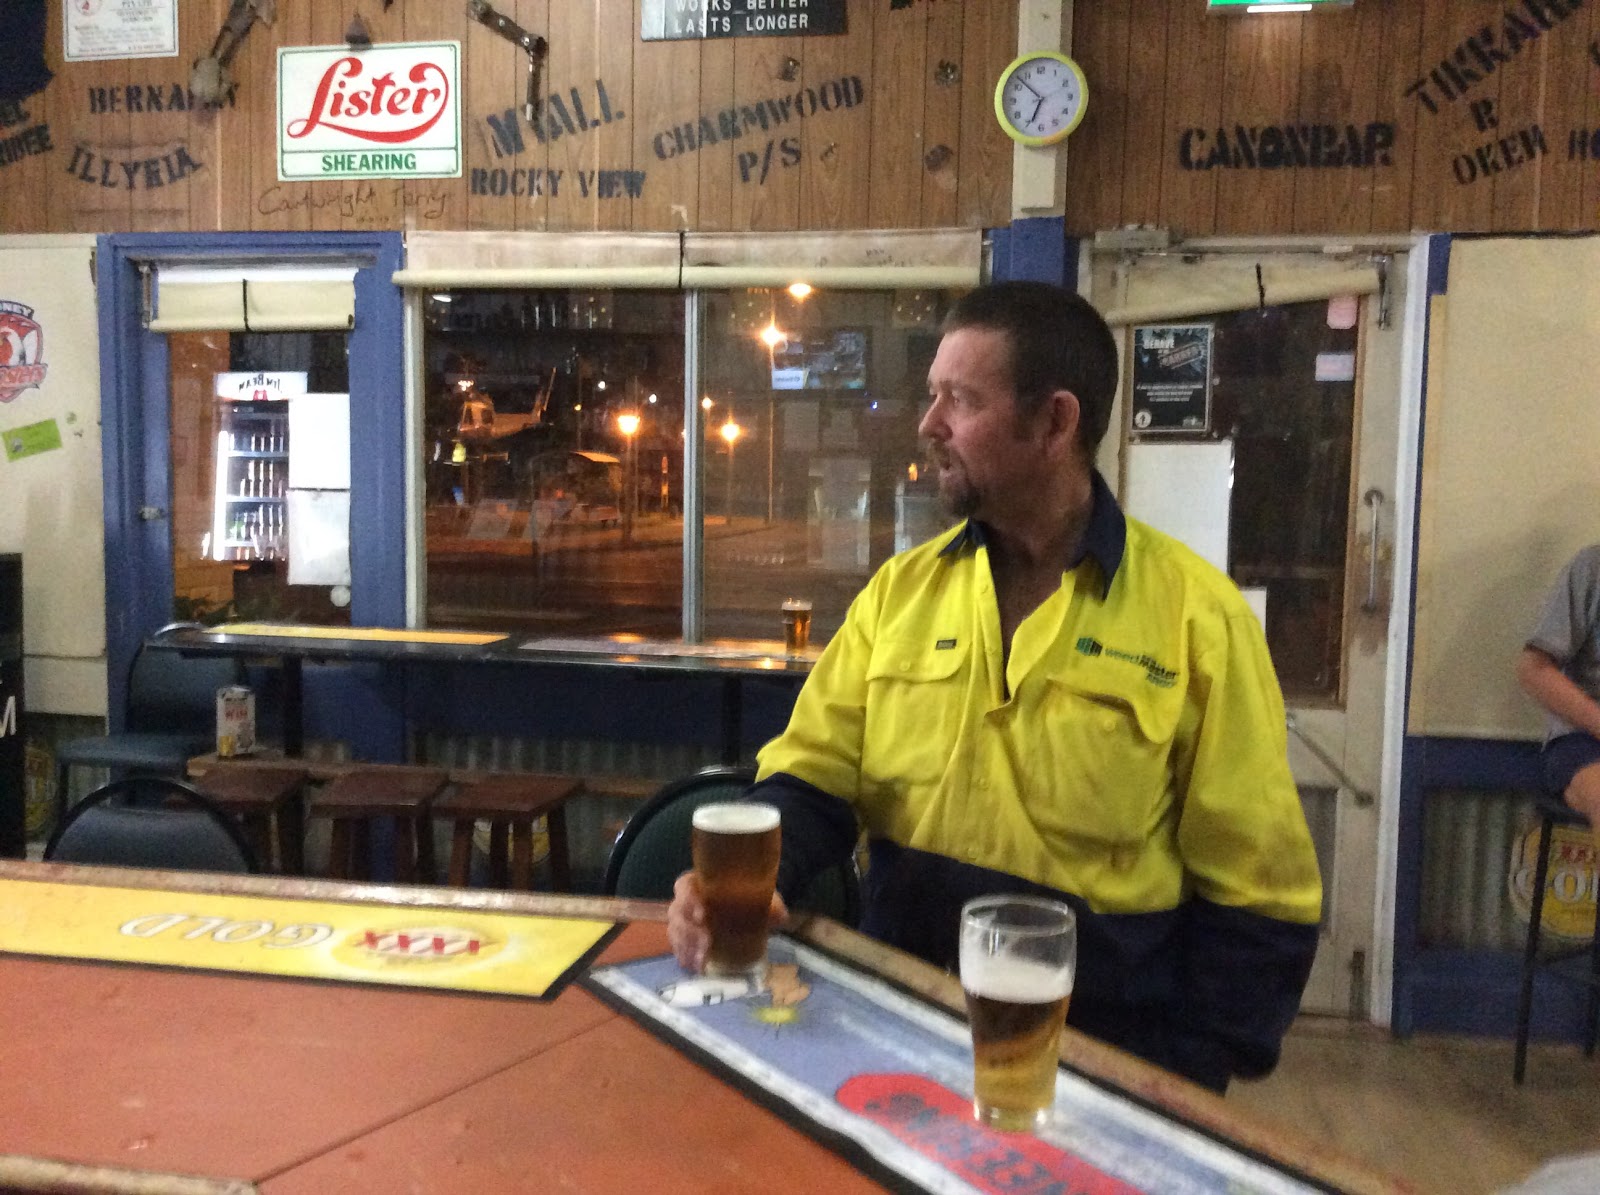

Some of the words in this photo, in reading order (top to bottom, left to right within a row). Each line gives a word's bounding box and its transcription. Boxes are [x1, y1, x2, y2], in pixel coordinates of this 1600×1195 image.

[675, 16, 731, 34] LASTS
[746, 13, 809, 32] LONGER
[287, 56, 449, 144] Lister
[322, 153, 417, 172] SHEARING
[738, 138, 801, 185] P/S
[471, 167, 563, 198] ROCKY
[578, 169, 646, 199] VIEW
[118, 912, 334, 949] GOLD
